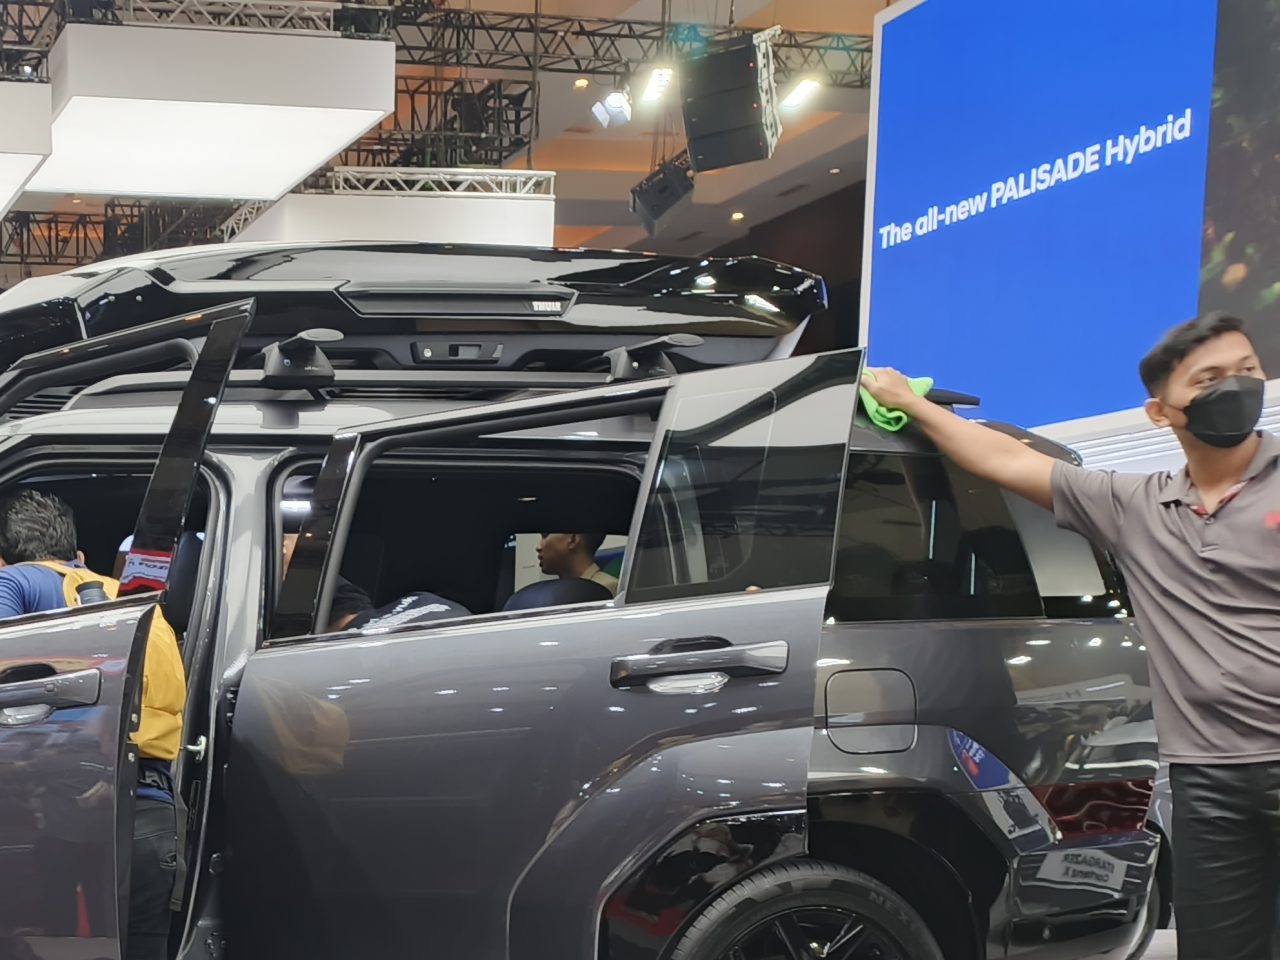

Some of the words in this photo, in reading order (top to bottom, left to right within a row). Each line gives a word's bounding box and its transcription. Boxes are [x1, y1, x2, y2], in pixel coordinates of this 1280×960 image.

[878, 221, 913, 249] The
[914, 191, 988, 236] all-new
[990, 143, 1101, 208] PALISADE
[1104, 107, 1192, 165] Hybrid
